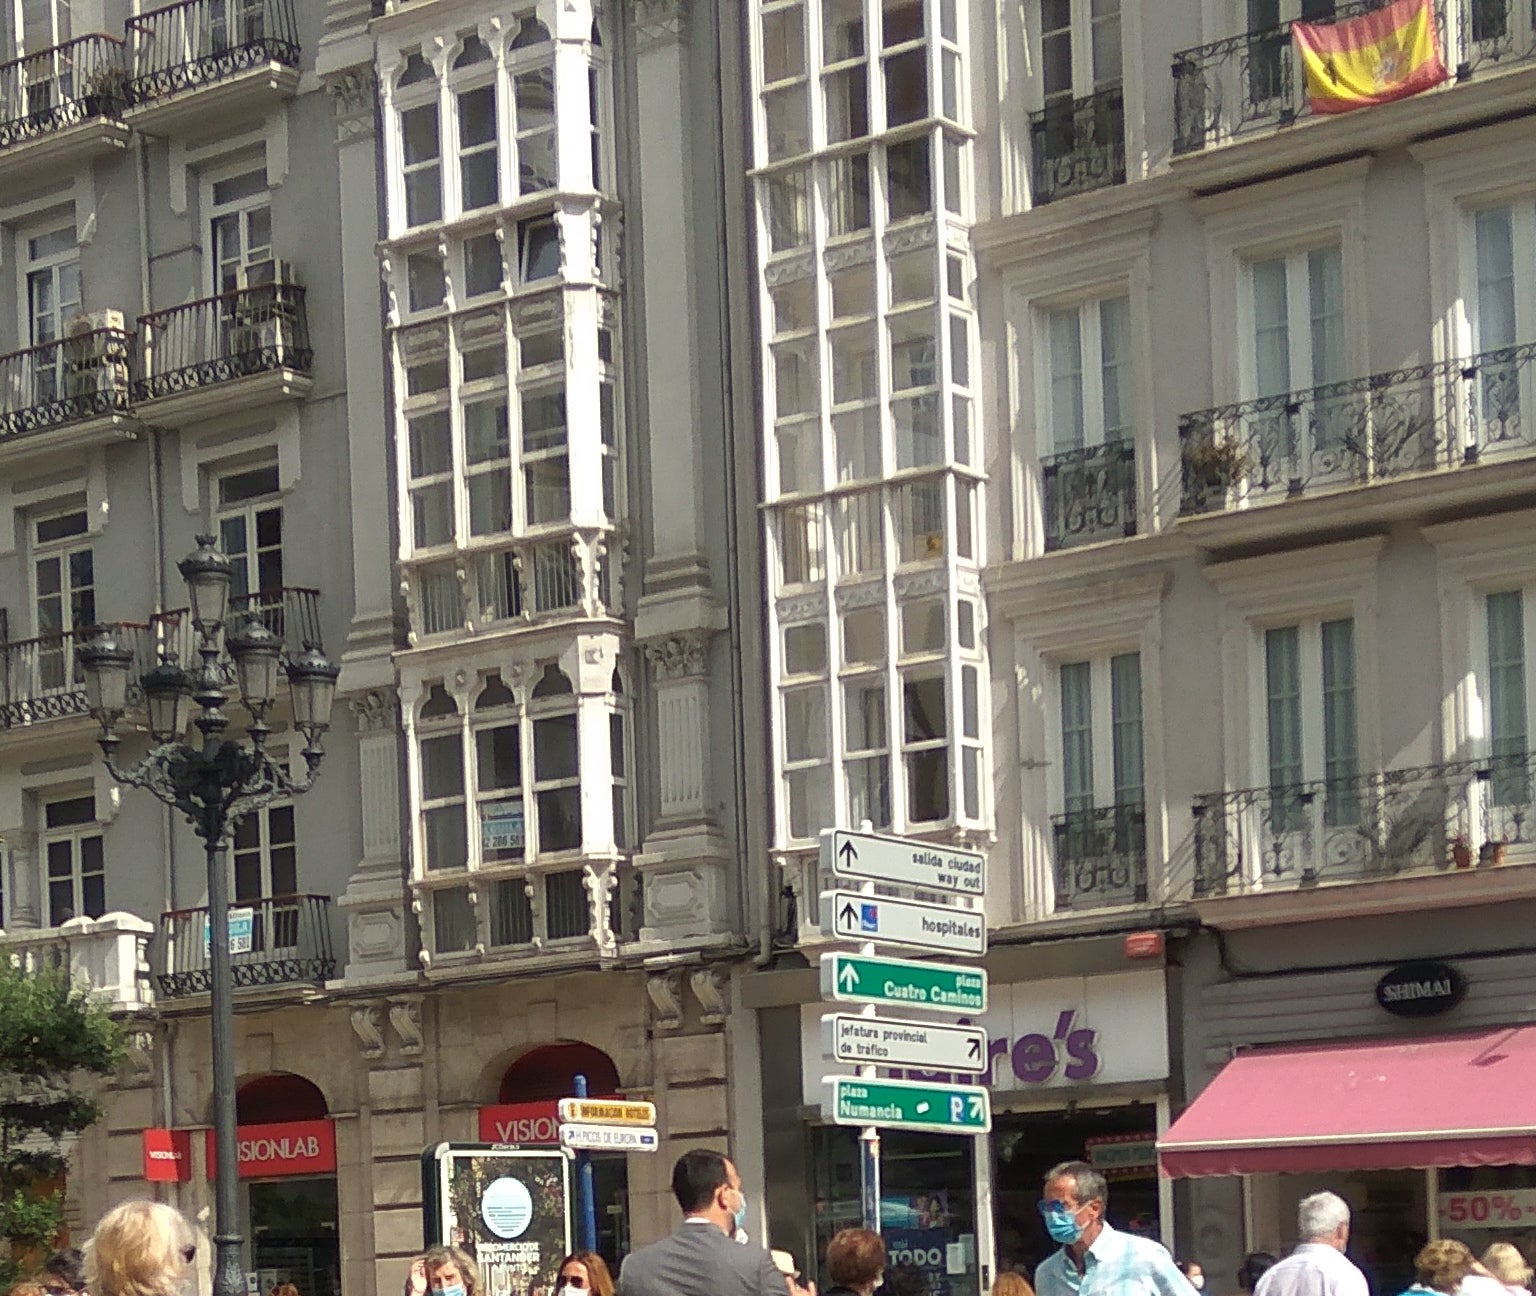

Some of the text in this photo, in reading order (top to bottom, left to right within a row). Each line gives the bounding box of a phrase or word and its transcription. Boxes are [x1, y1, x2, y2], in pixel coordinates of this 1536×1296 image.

[912, 853, 981, 874] salida ciudad
[937, 872, 980, 888] way out
[922, 916, 981, 938] hospitales
[955, 974, 981, 988] plaza
[1384, 979, 1452, 1001] SHIMAI
[884, 981, 981, 1006] Cuatro Caminos
[841, 1023, 928, 1044] jefatura provincial
[840, 1042, 852, 1053] de
[840, 1084, 868, 1098] plaza
[840, 1100, 903, 1119] Numancia
[238, 1136, 320, 1163] ISIONLAB
[888, 1248, 942, 1266] TODO
